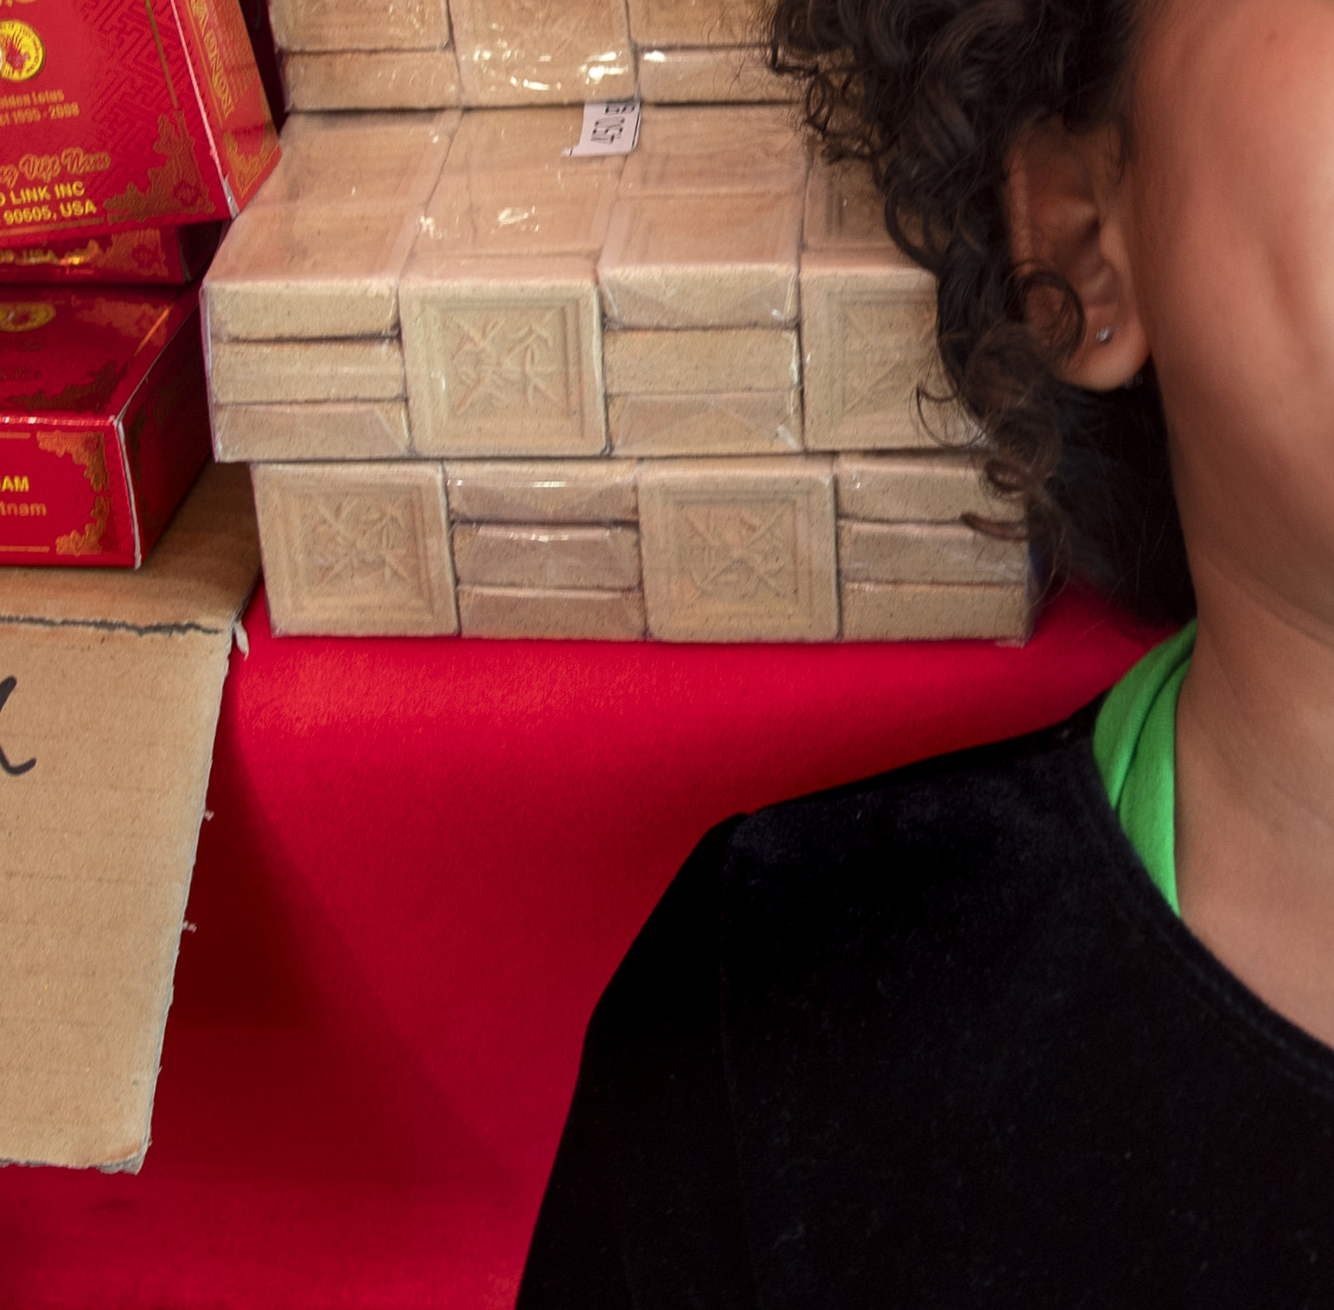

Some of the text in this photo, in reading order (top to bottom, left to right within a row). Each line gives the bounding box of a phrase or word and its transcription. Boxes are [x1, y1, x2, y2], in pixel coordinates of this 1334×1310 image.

[10, 186, 51, 206] LINK
[54, 181, 85, 199] INC
[59, 199, 97, 218] USA
